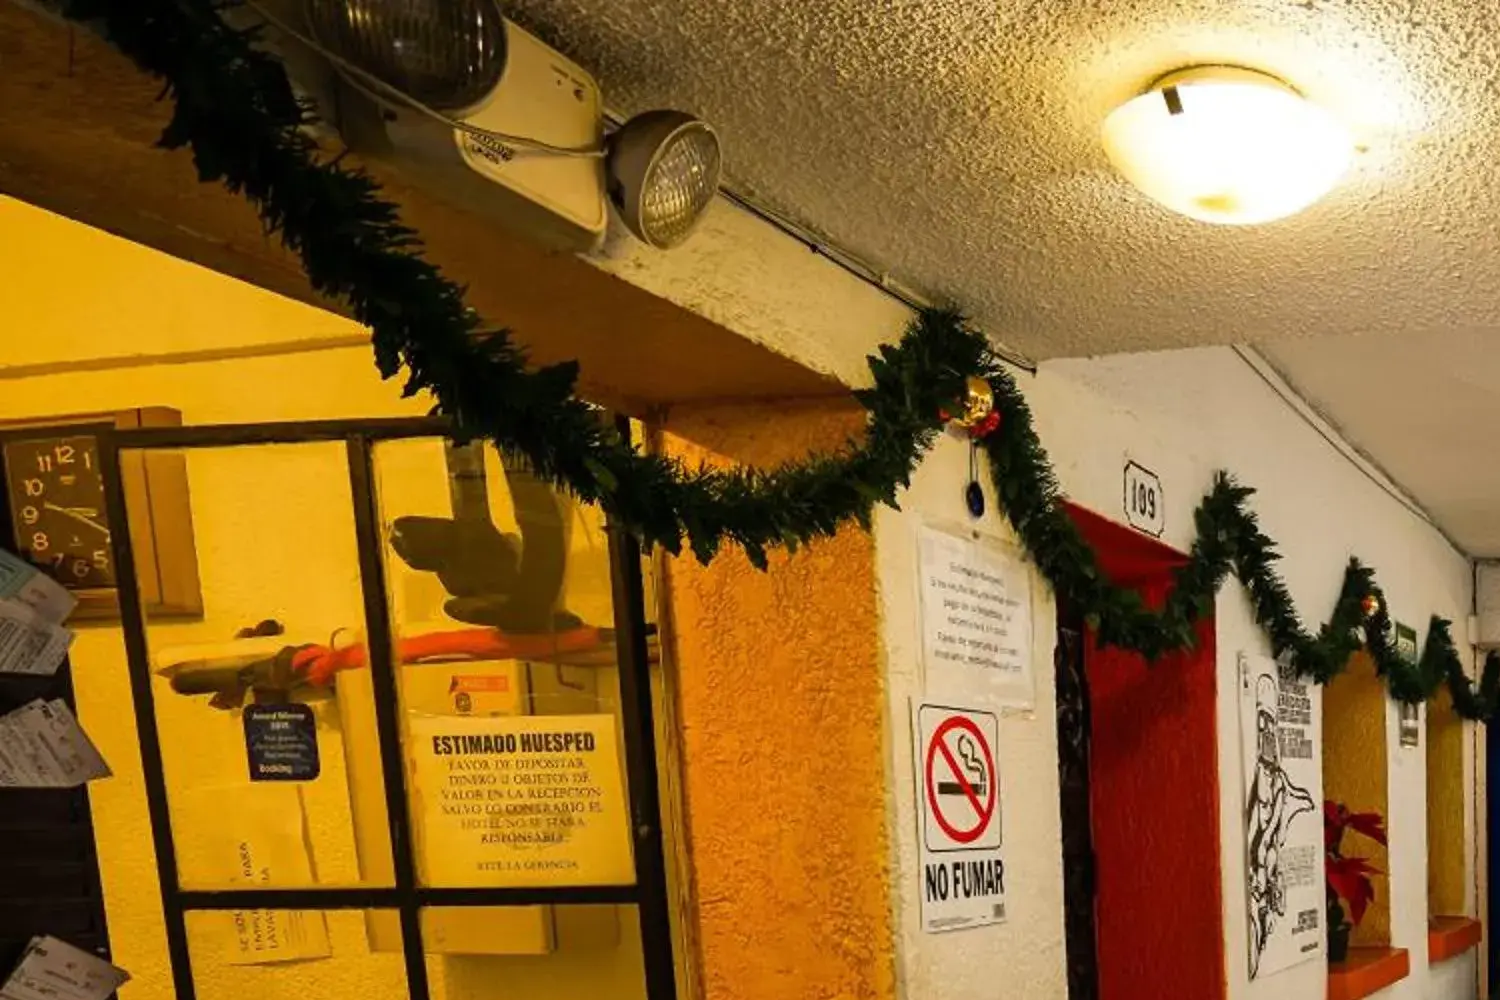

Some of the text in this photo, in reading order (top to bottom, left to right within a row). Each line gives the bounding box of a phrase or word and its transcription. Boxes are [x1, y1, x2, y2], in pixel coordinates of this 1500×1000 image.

[55, 445, 75, 464] 12
[25, 478, 44, 496] 10
[1132, 477, 1155, 520] 109
[23, 506, 38, 525] 9
[33, 532, 49, 551] 8
[432, 731, 595, 755] ESTIMADO HUESPED
[925, 859, 1004, 902] NO FUMAR
